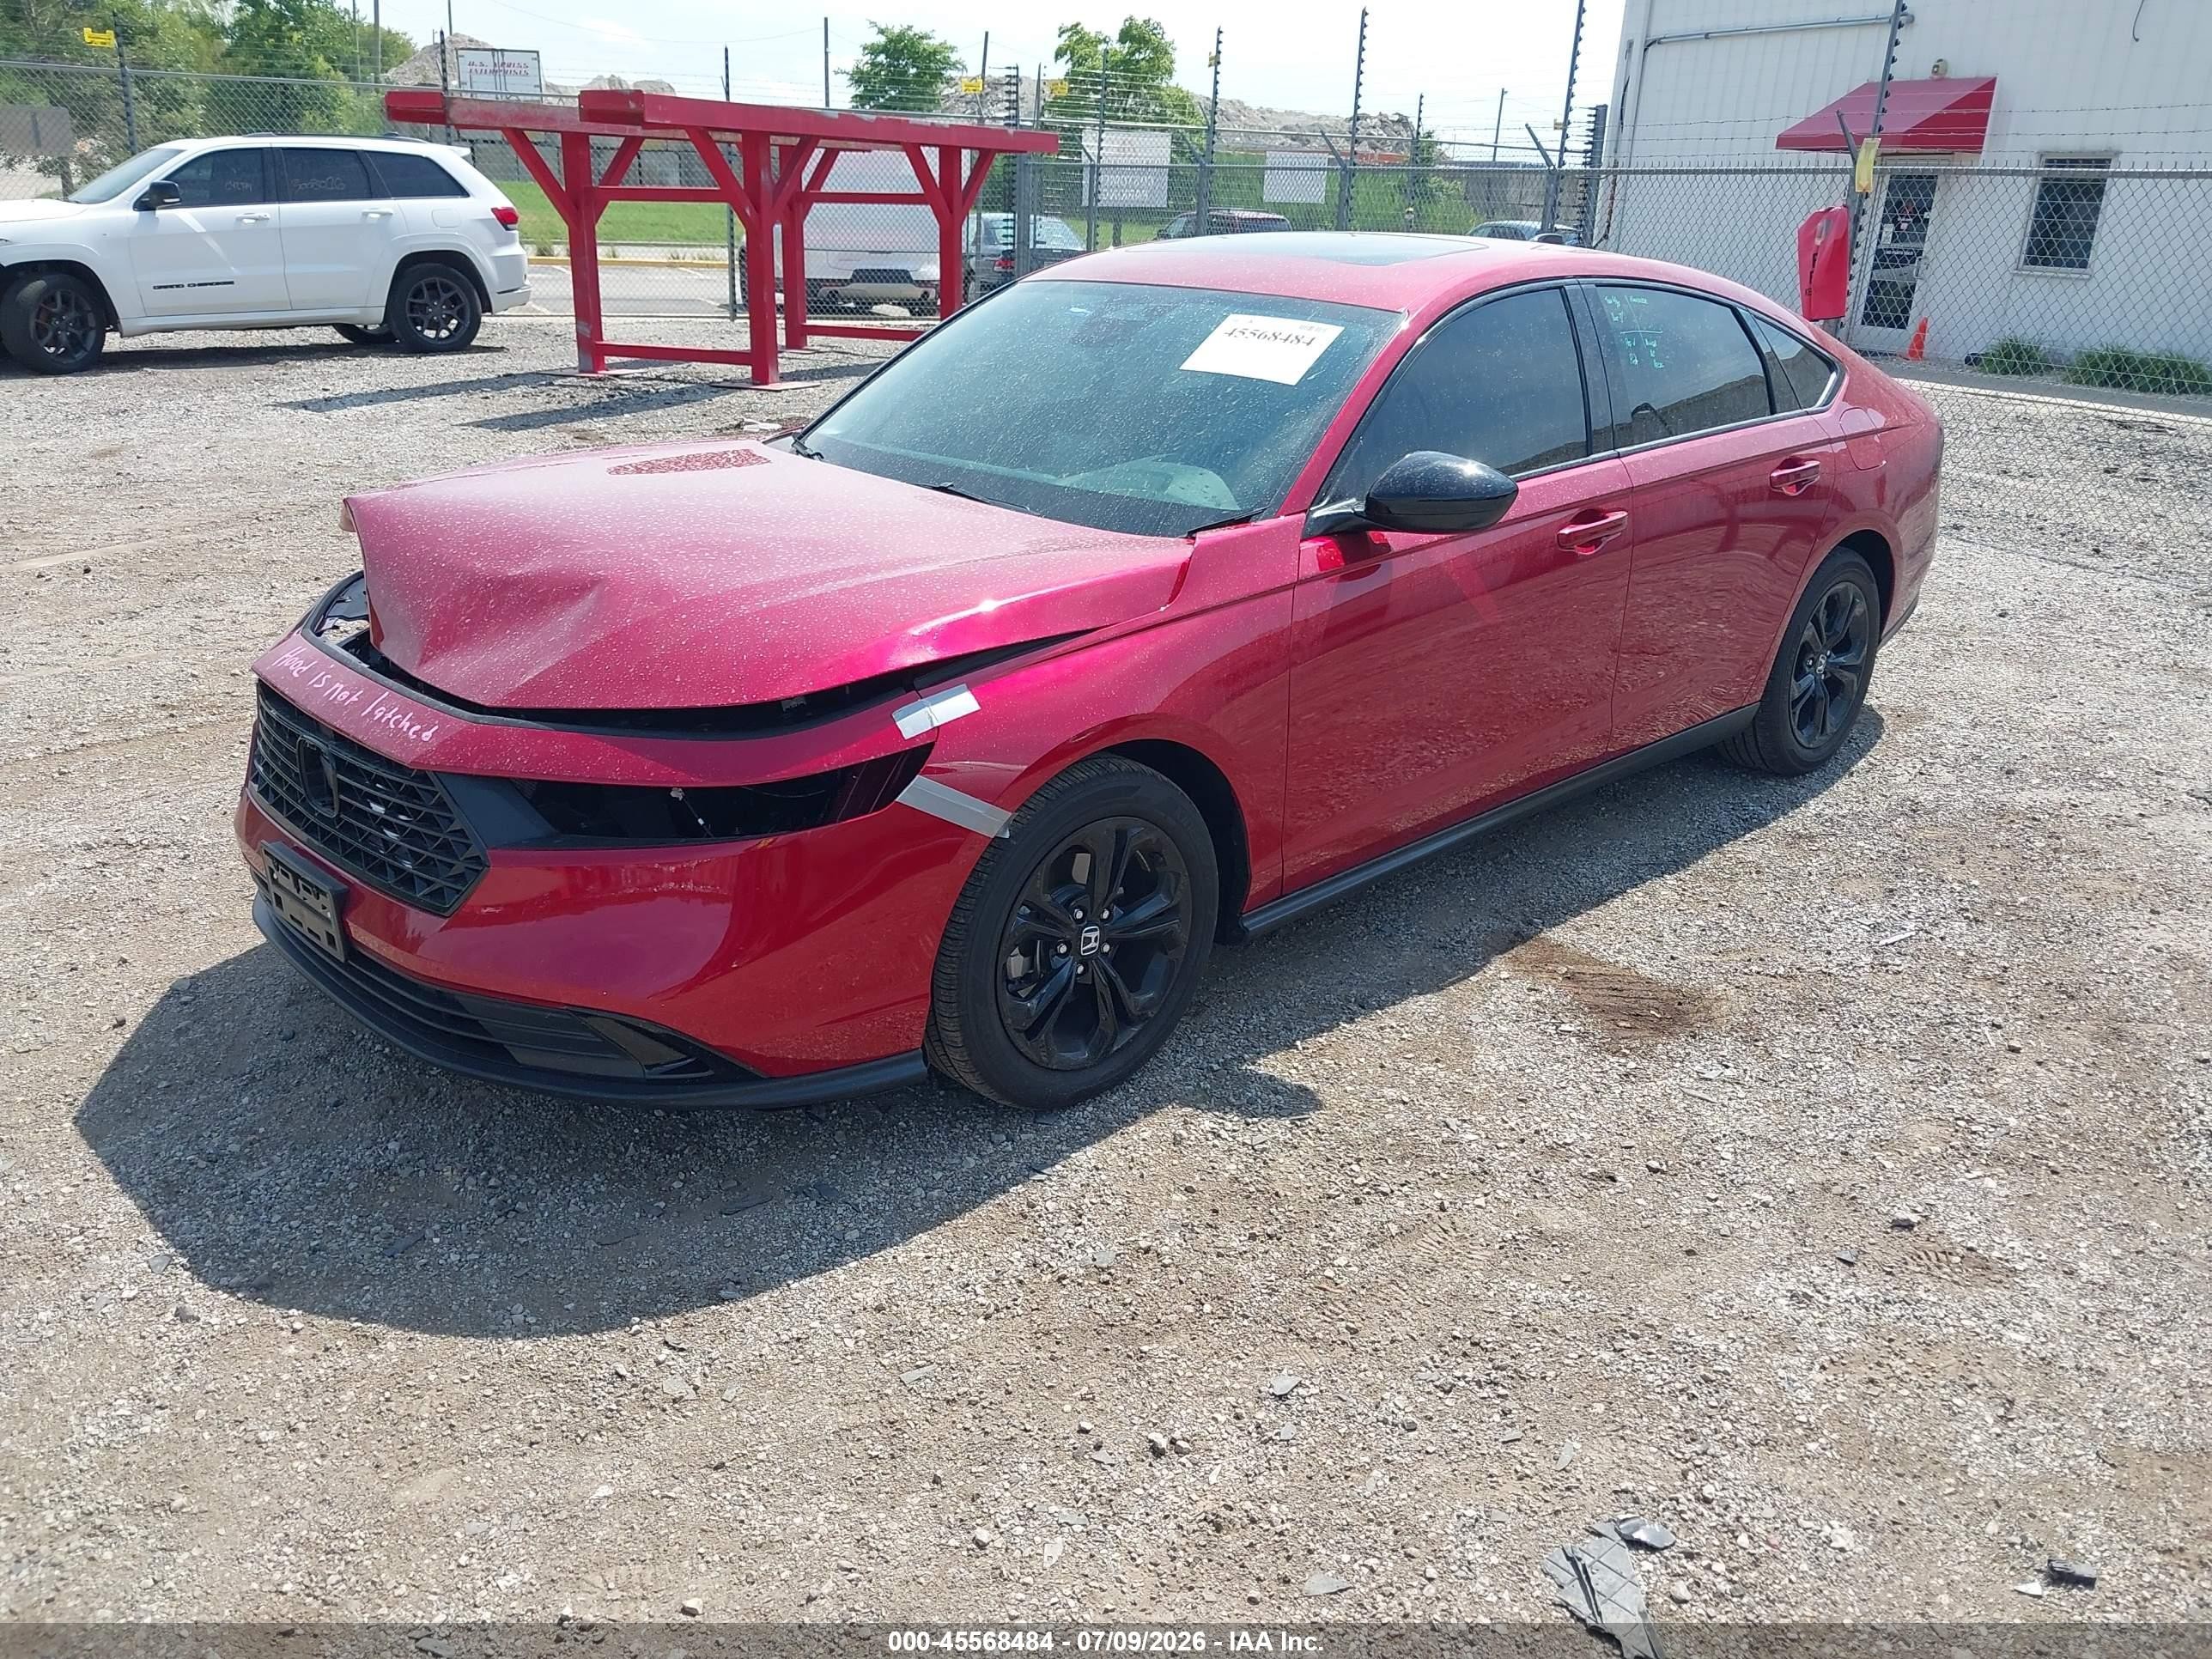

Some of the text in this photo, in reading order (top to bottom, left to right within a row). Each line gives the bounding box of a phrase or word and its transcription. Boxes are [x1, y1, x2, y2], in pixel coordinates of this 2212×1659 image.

[1224, 327, 1316, 347] 45568484
[271, 646, 439, 742] Hood is not latched
